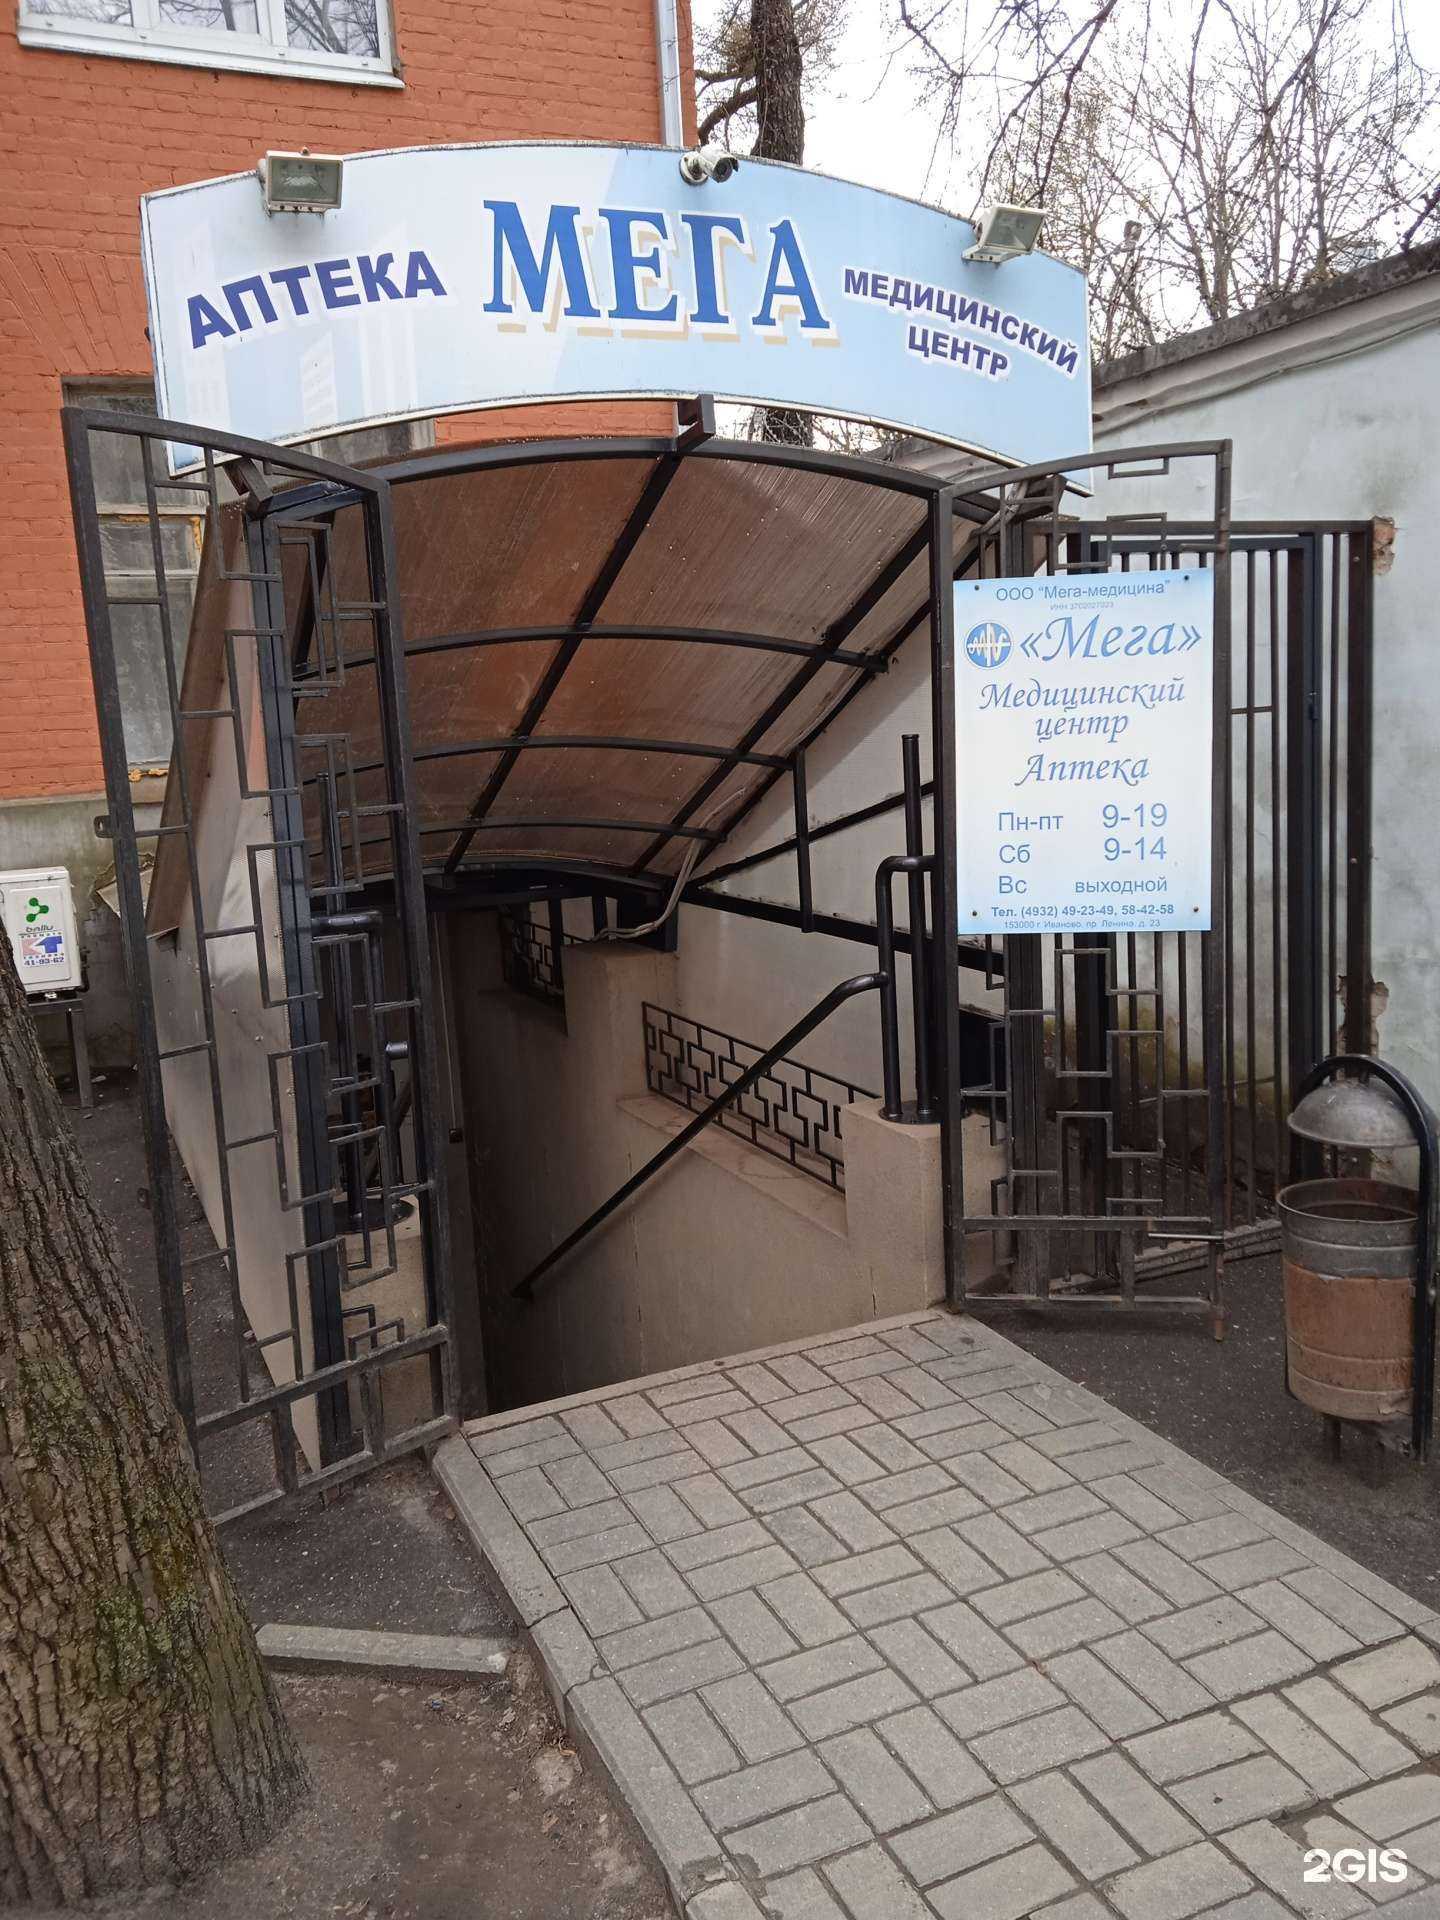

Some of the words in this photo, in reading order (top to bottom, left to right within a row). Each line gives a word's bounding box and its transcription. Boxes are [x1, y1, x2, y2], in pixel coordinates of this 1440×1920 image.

[483, 199, 831, 330] МЕГА
[187, 250, 447, 350] АПТЕКА
[845, 268, 1079, 374] МЕДИЦИНСКИЙ
[908, 326, 1009, 376] ЦЕНТР
[996, 586, 1034, 601] ООО
[1020, 614, 1202, 662] «Мега»
[979, 677, 1185, 712] Медицинский
[1035, 713, 1129, 743] центр
[1014, 753, 1150, 786] Аптека
[998, 812, 1064, 831] Пн-пт
[1102, 803, 1168, 828] 9-19
[999, 844, 1031, 864] Сб
[1103, 836, 1167, 861] 9-14
[998, 876, 1028, 894] Вс
[1075, 877, 1168, 894] выходной
[991, 907, 1017, 917] Тел.
[1021, 906, 1058, 918] (4932)
[1062, 905, 1117, 917] 49-23-49,
[1121, 904, 1174, 915] 58-42-58
[1004, 920, 1035, 929] 153000
[1150, 919, 1161, 928] 23
